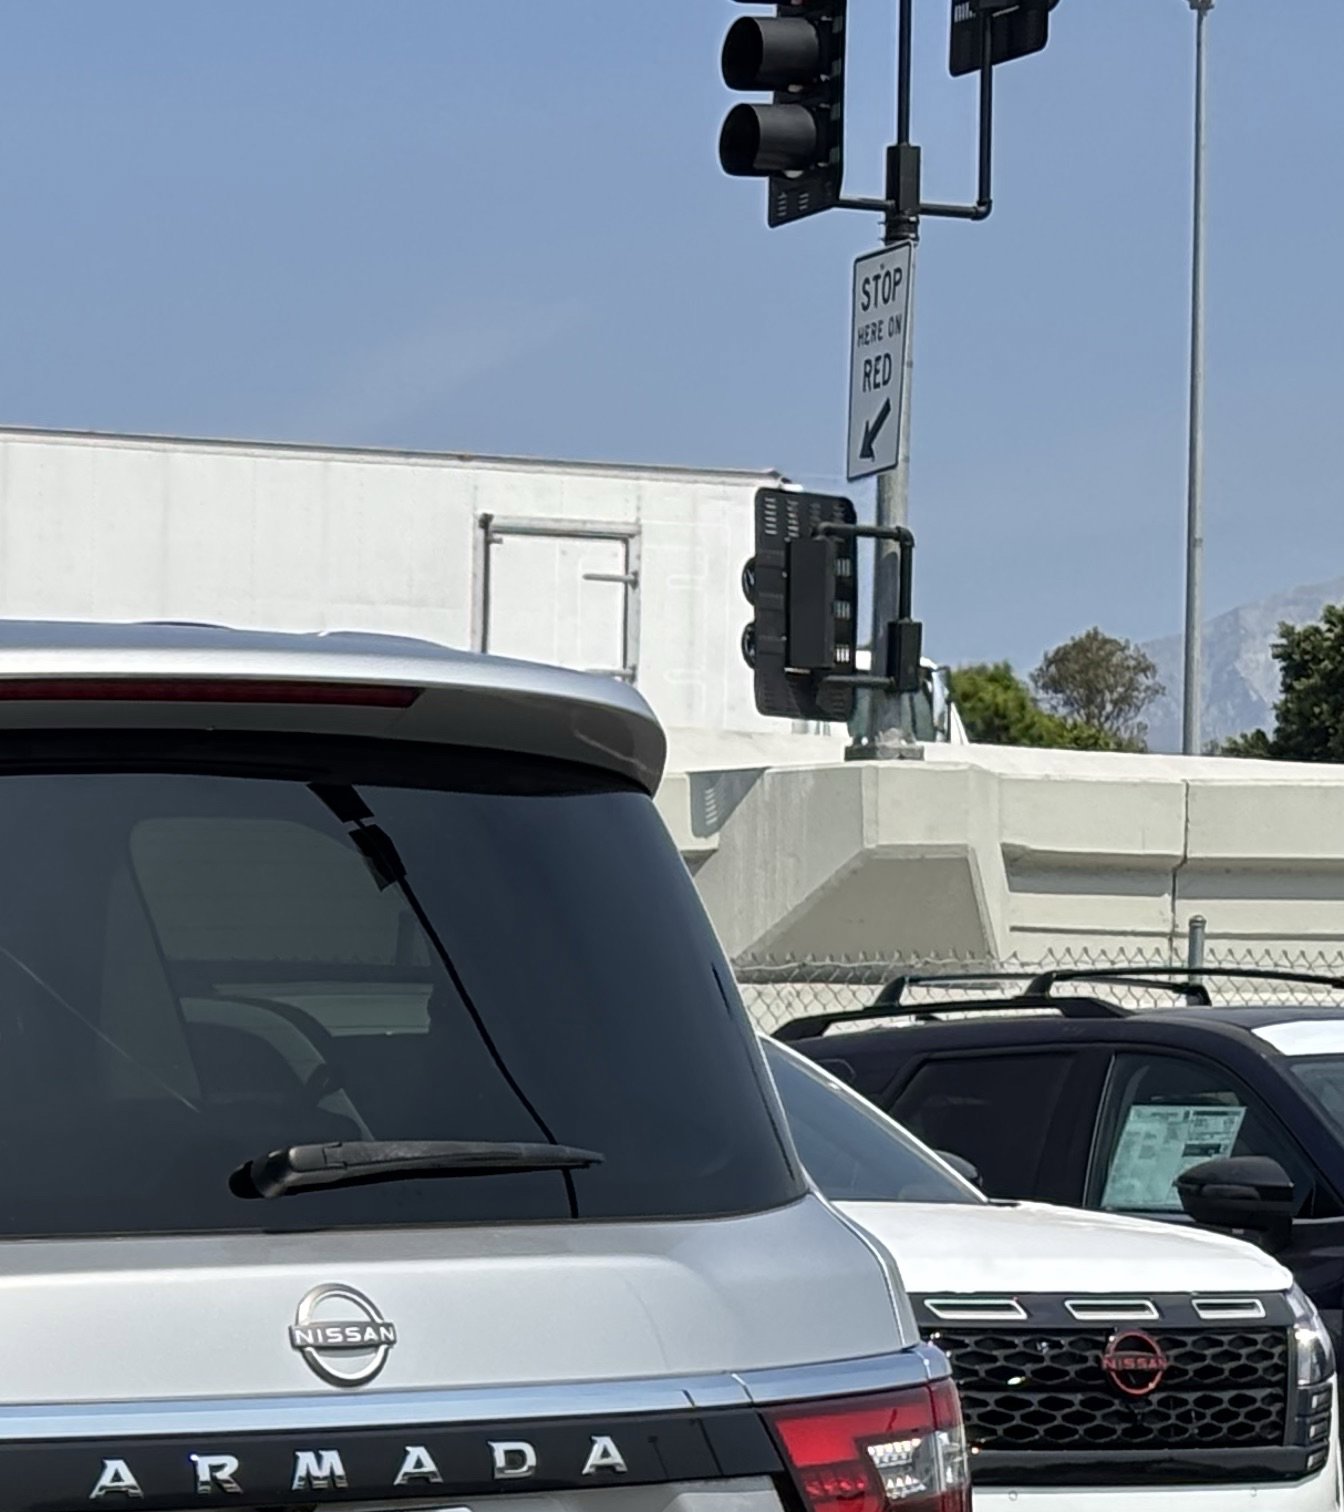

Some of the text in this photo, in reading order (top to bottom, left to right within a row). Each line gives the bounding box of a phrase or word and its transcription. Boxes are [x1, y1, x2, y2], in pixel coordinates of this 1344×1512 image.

[861, 266, 903, 313] STOP
[857, 313, 902, 348] HERE ON
[862, 352, 892, 393] RED
[294, 1326, 394, 1344] NISSAN
[1102, 1358, 1166, 1371] NISSAN
[89, 1435, 628, 1499] ARMADA
